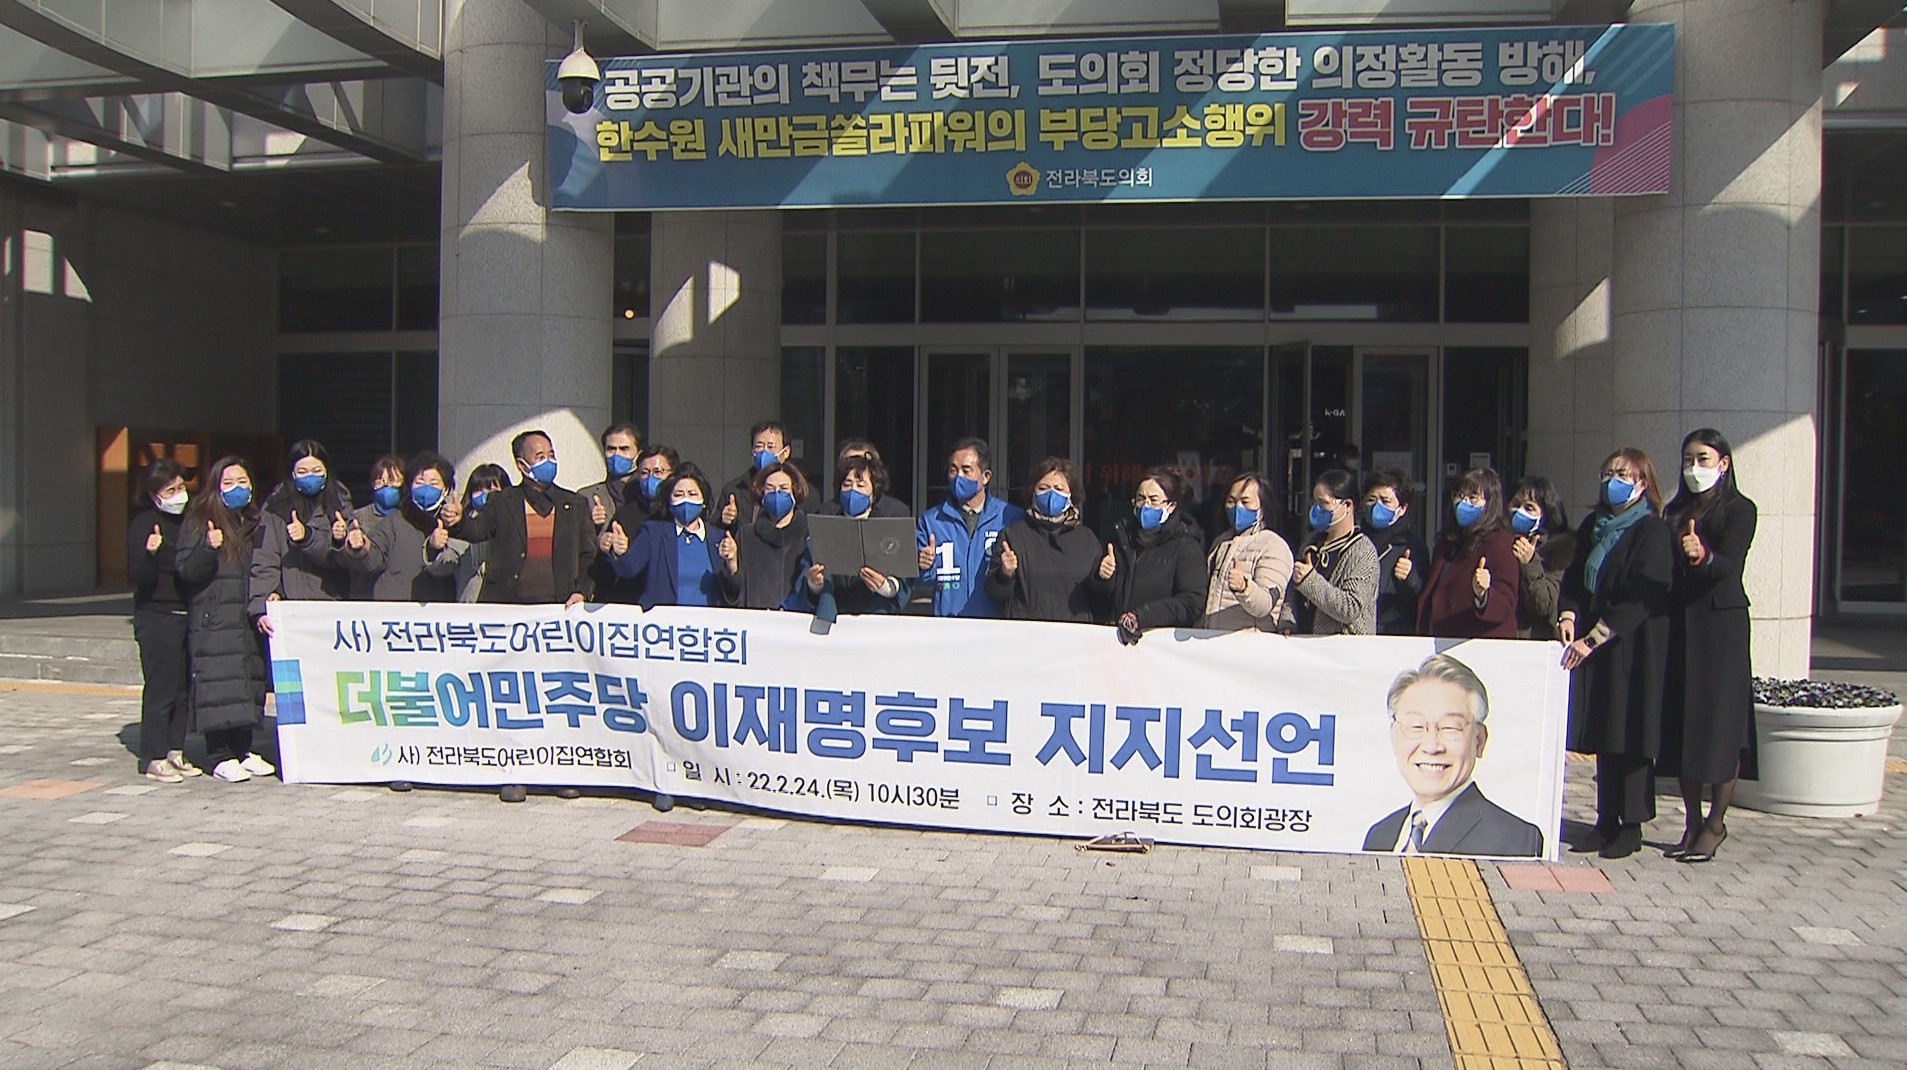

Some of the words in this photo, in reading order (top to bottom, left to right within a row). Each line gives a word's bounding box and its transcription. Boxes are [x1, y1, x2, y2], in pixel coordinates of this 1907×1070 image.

[604, 63, 790, 110] 공공기관의
[801, 59, 918, 104] 책무는
[930, 54, 1021, 101] 뒷전,
[1038, 48, 1160, 96] 도의회
[1173, 44, 1301, 93] 정당한
[1311, 40, 1484, 90] 의정활동
[1498, 39, 1597, 86] 방해,
[596, 118, 708, 162] 한수원
[1038, 102, 1286, 152] 부당고소행위
[1297, 96, 1395, 151] 강력
[1405, 91, 1616, 150] 규탄한다!
[1046, 167, 1153, 188] 전라북도의회
[936, 542, 960, 575] 1
[334, 621, 372, 653] 사)
[382, 620, 747, 666] 전라북도어린이집연합회
[336, 670, 647, 733] 더불어민주당
[671, 680, 1011, 766] 이재명후보
[1035, 702, 1337, 787] 지지선언
[397, 747, 422, 767] 사)
[426, 746, 632, 770] 전라북도어린이집연합회
[683, 761, 702, 781] 일
[747, 771, 860, 802] 22.2.24.(목)
[867, 783, 961, 810] 10시30분
[1011, 791, 1033, 815] 장
[1048, 795, 1070, 817] 소
[1091, 797, 1183, 824] 전라북도
[1193, 804, 1312, 833] 도의회광장
